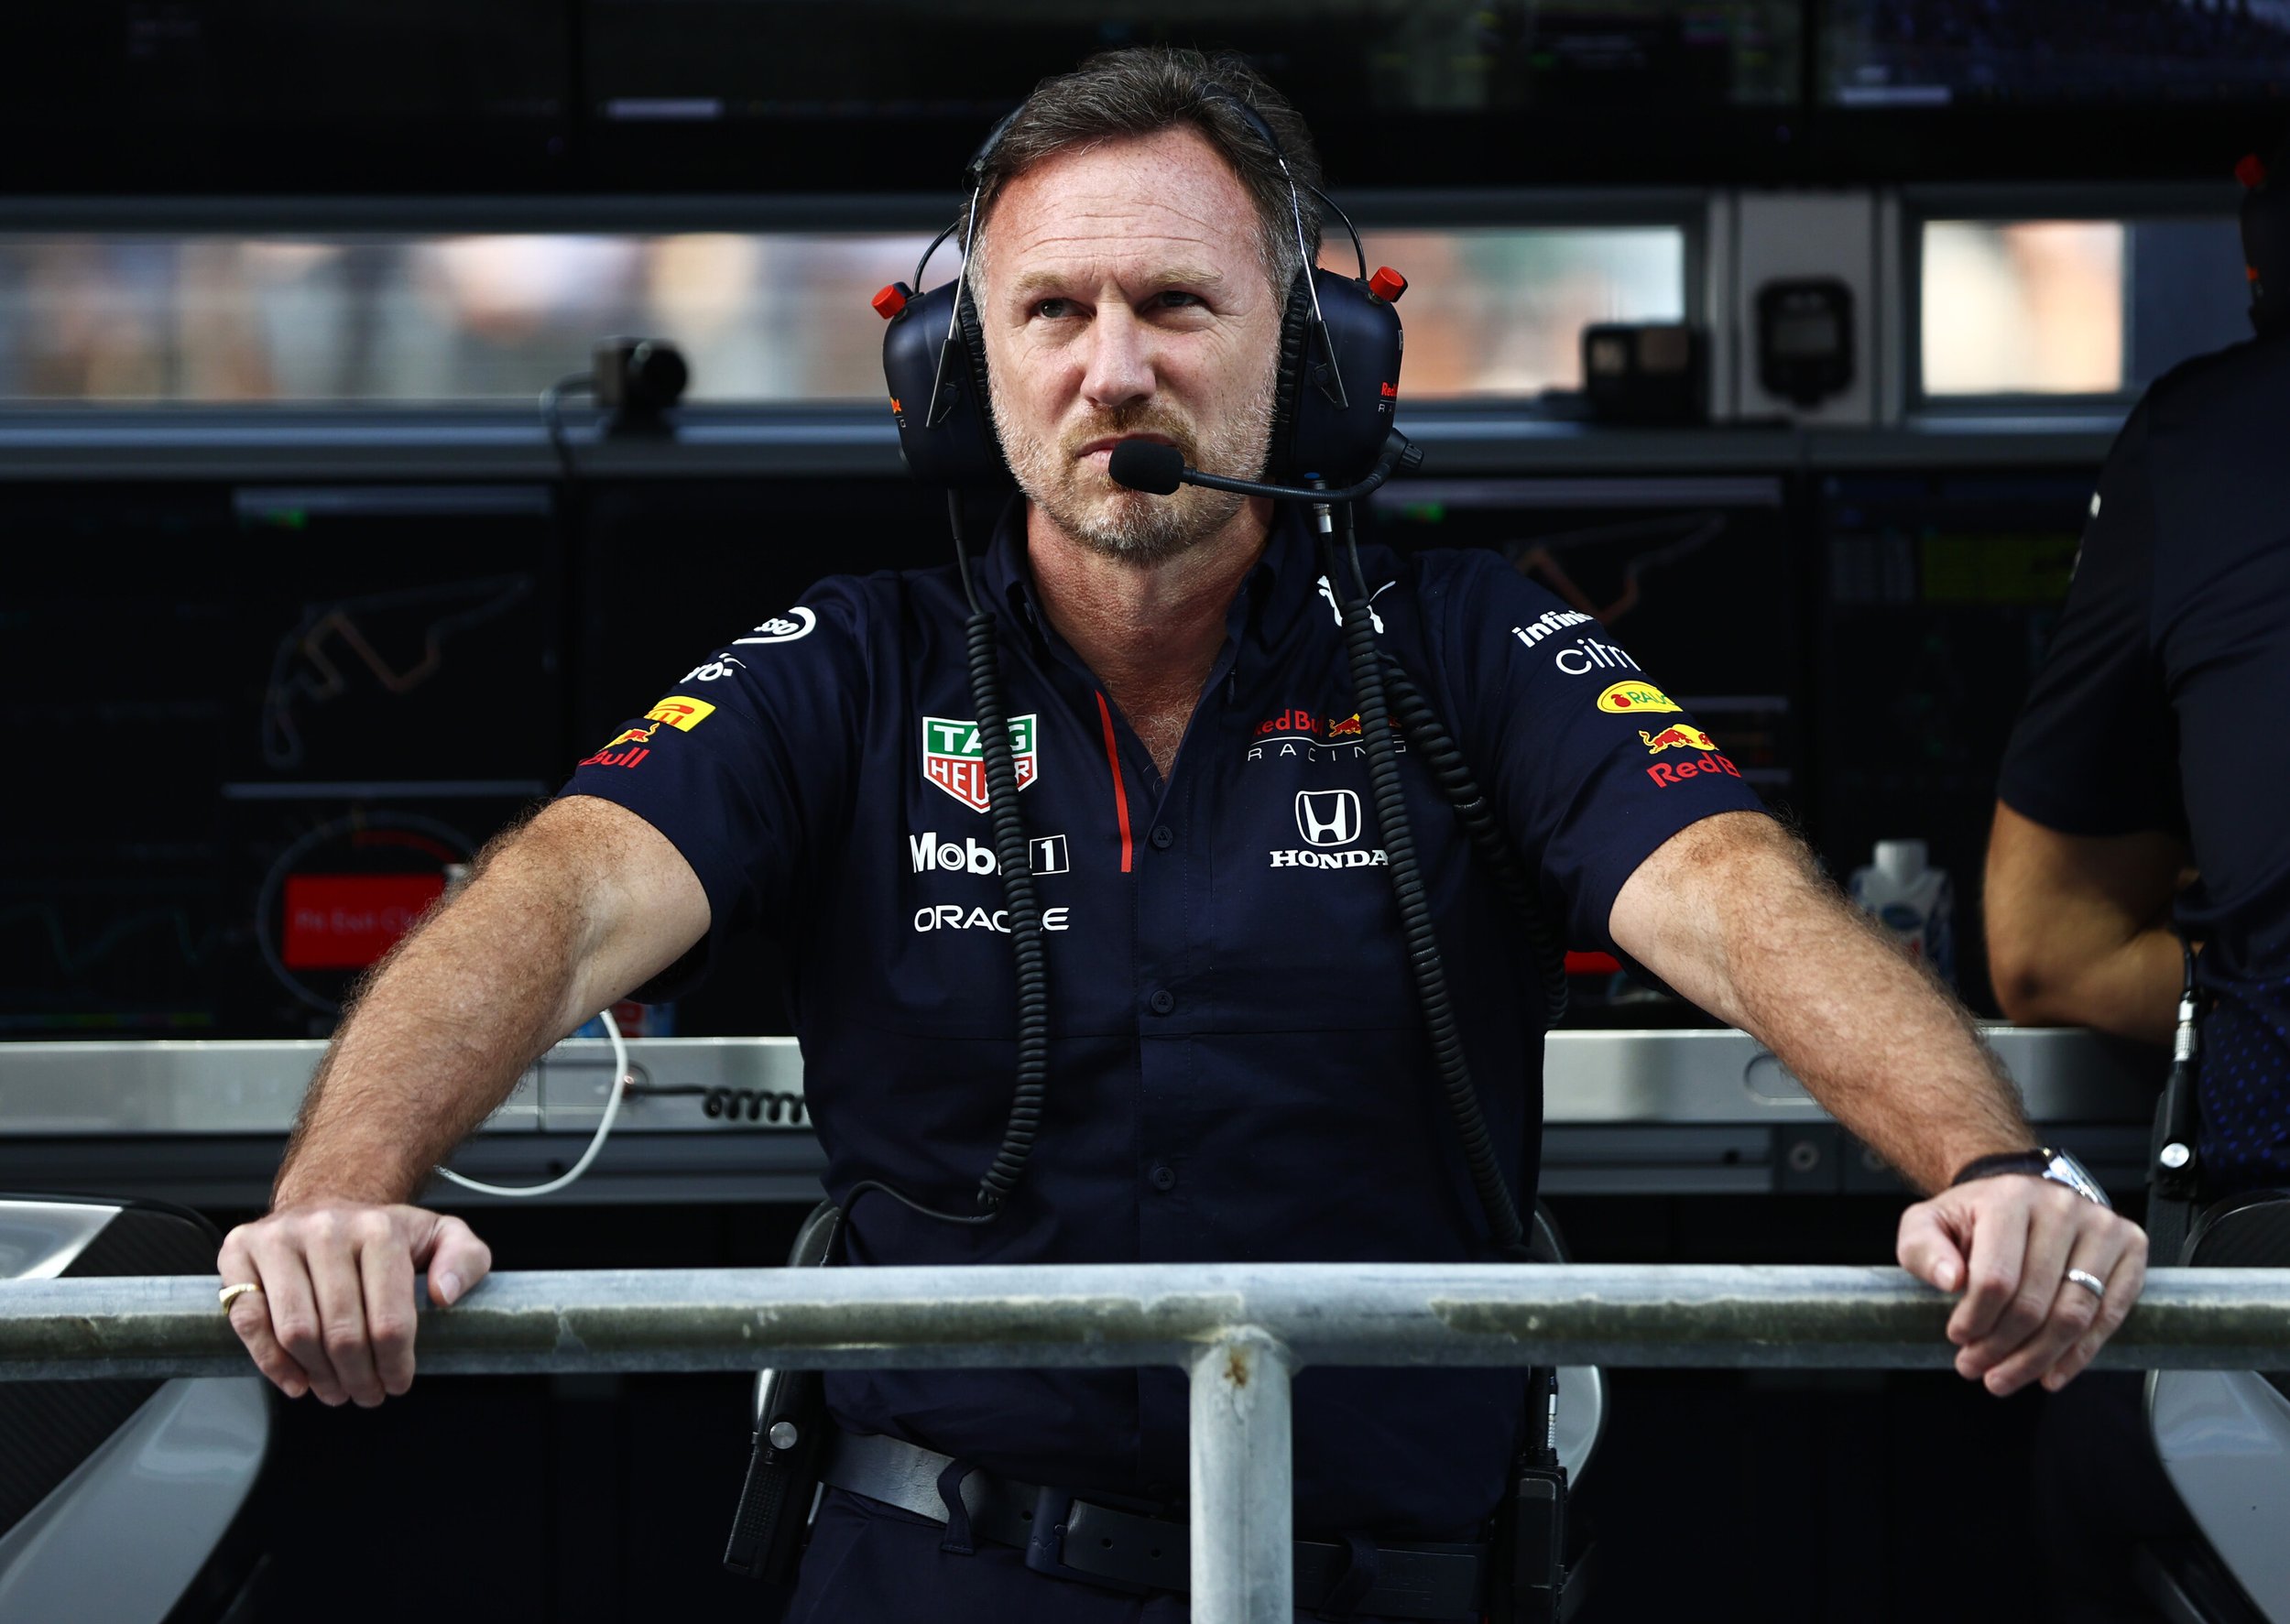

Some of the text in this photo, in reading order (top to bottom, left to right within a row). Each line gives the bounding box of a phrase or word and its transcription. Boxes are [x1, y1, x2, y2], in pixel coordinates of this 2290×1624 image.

[931, 758, 1030, 806] HEUR
[1646, 751, 1722, 789] Red
[910, 832, 1002, 876] Mob
[1270, 850, 1390, 869] HONDA
[914, 904, 1070, 932] ORACE
